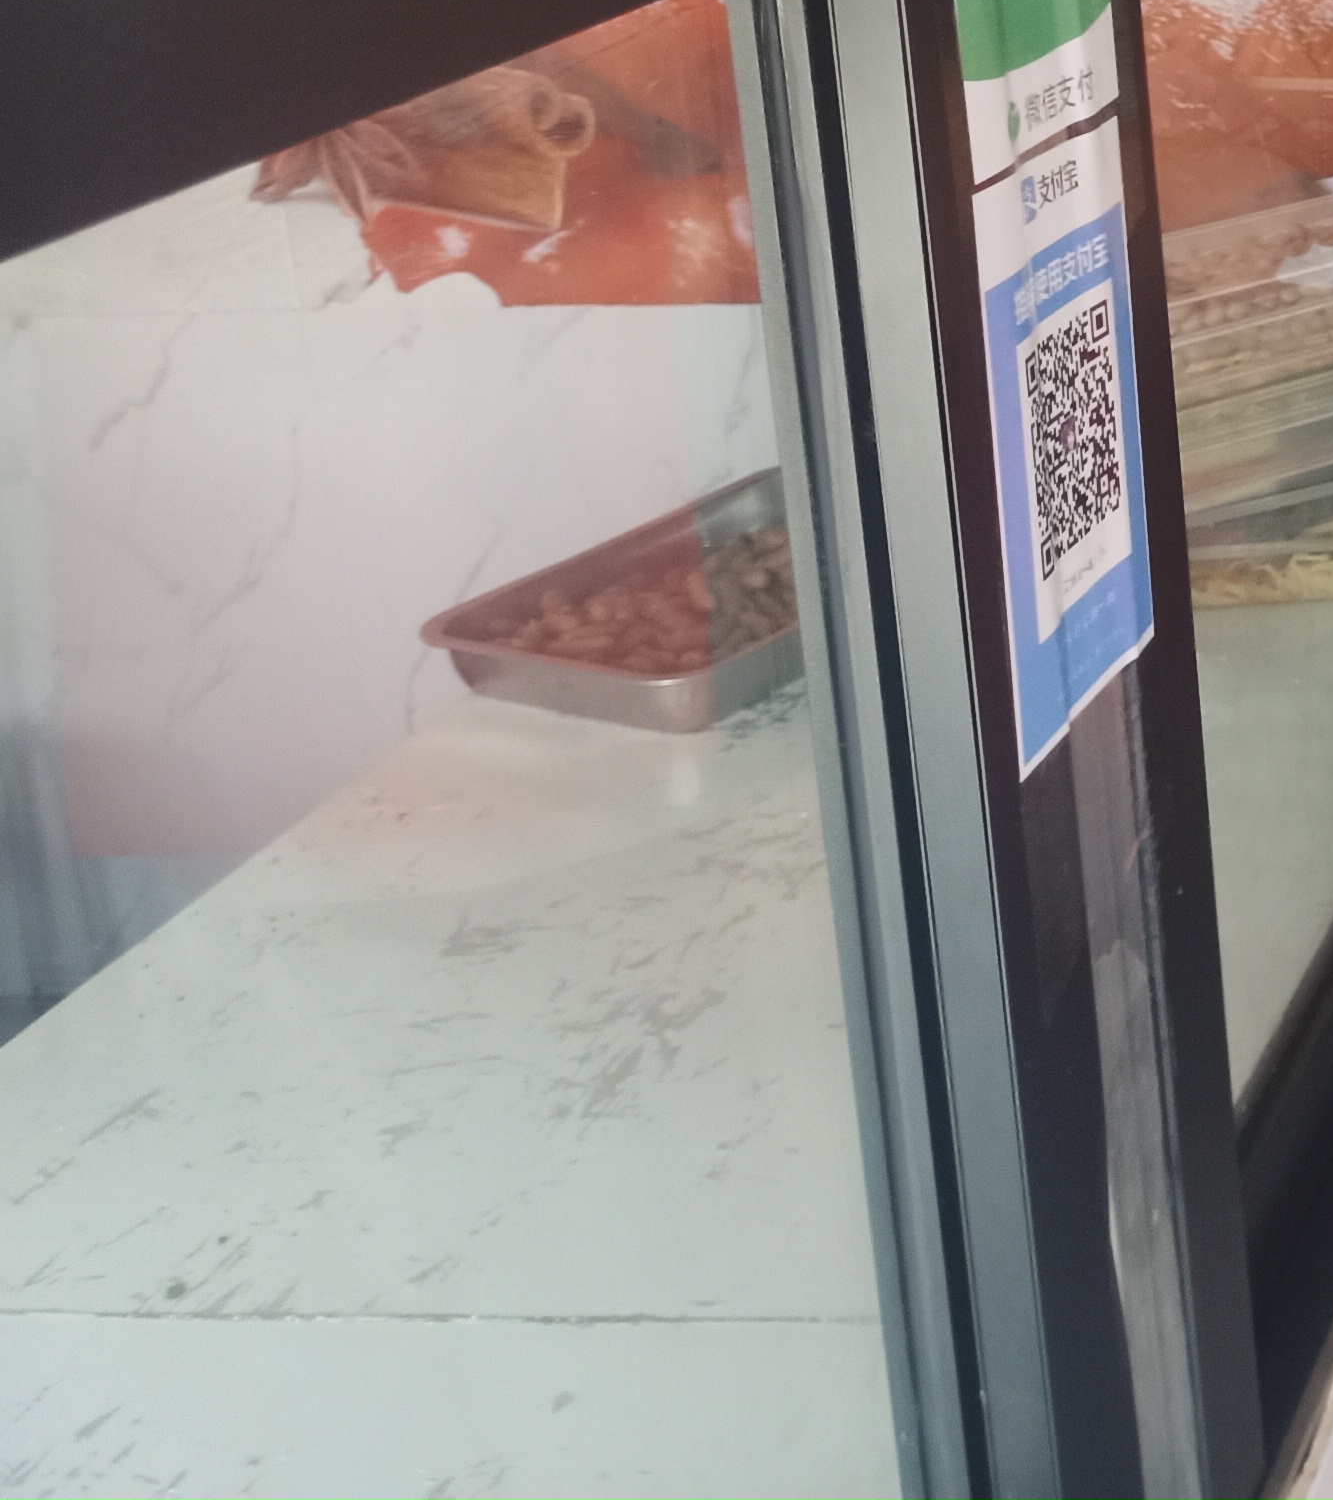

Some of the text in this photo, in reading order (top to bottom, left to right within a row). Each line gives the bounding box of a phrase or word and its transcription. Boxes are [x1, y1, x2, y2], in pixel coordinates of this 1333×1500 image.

[1023, 64, 1095, 134] 微信支付
[1036, 159, 1080, 210] 支付宝
